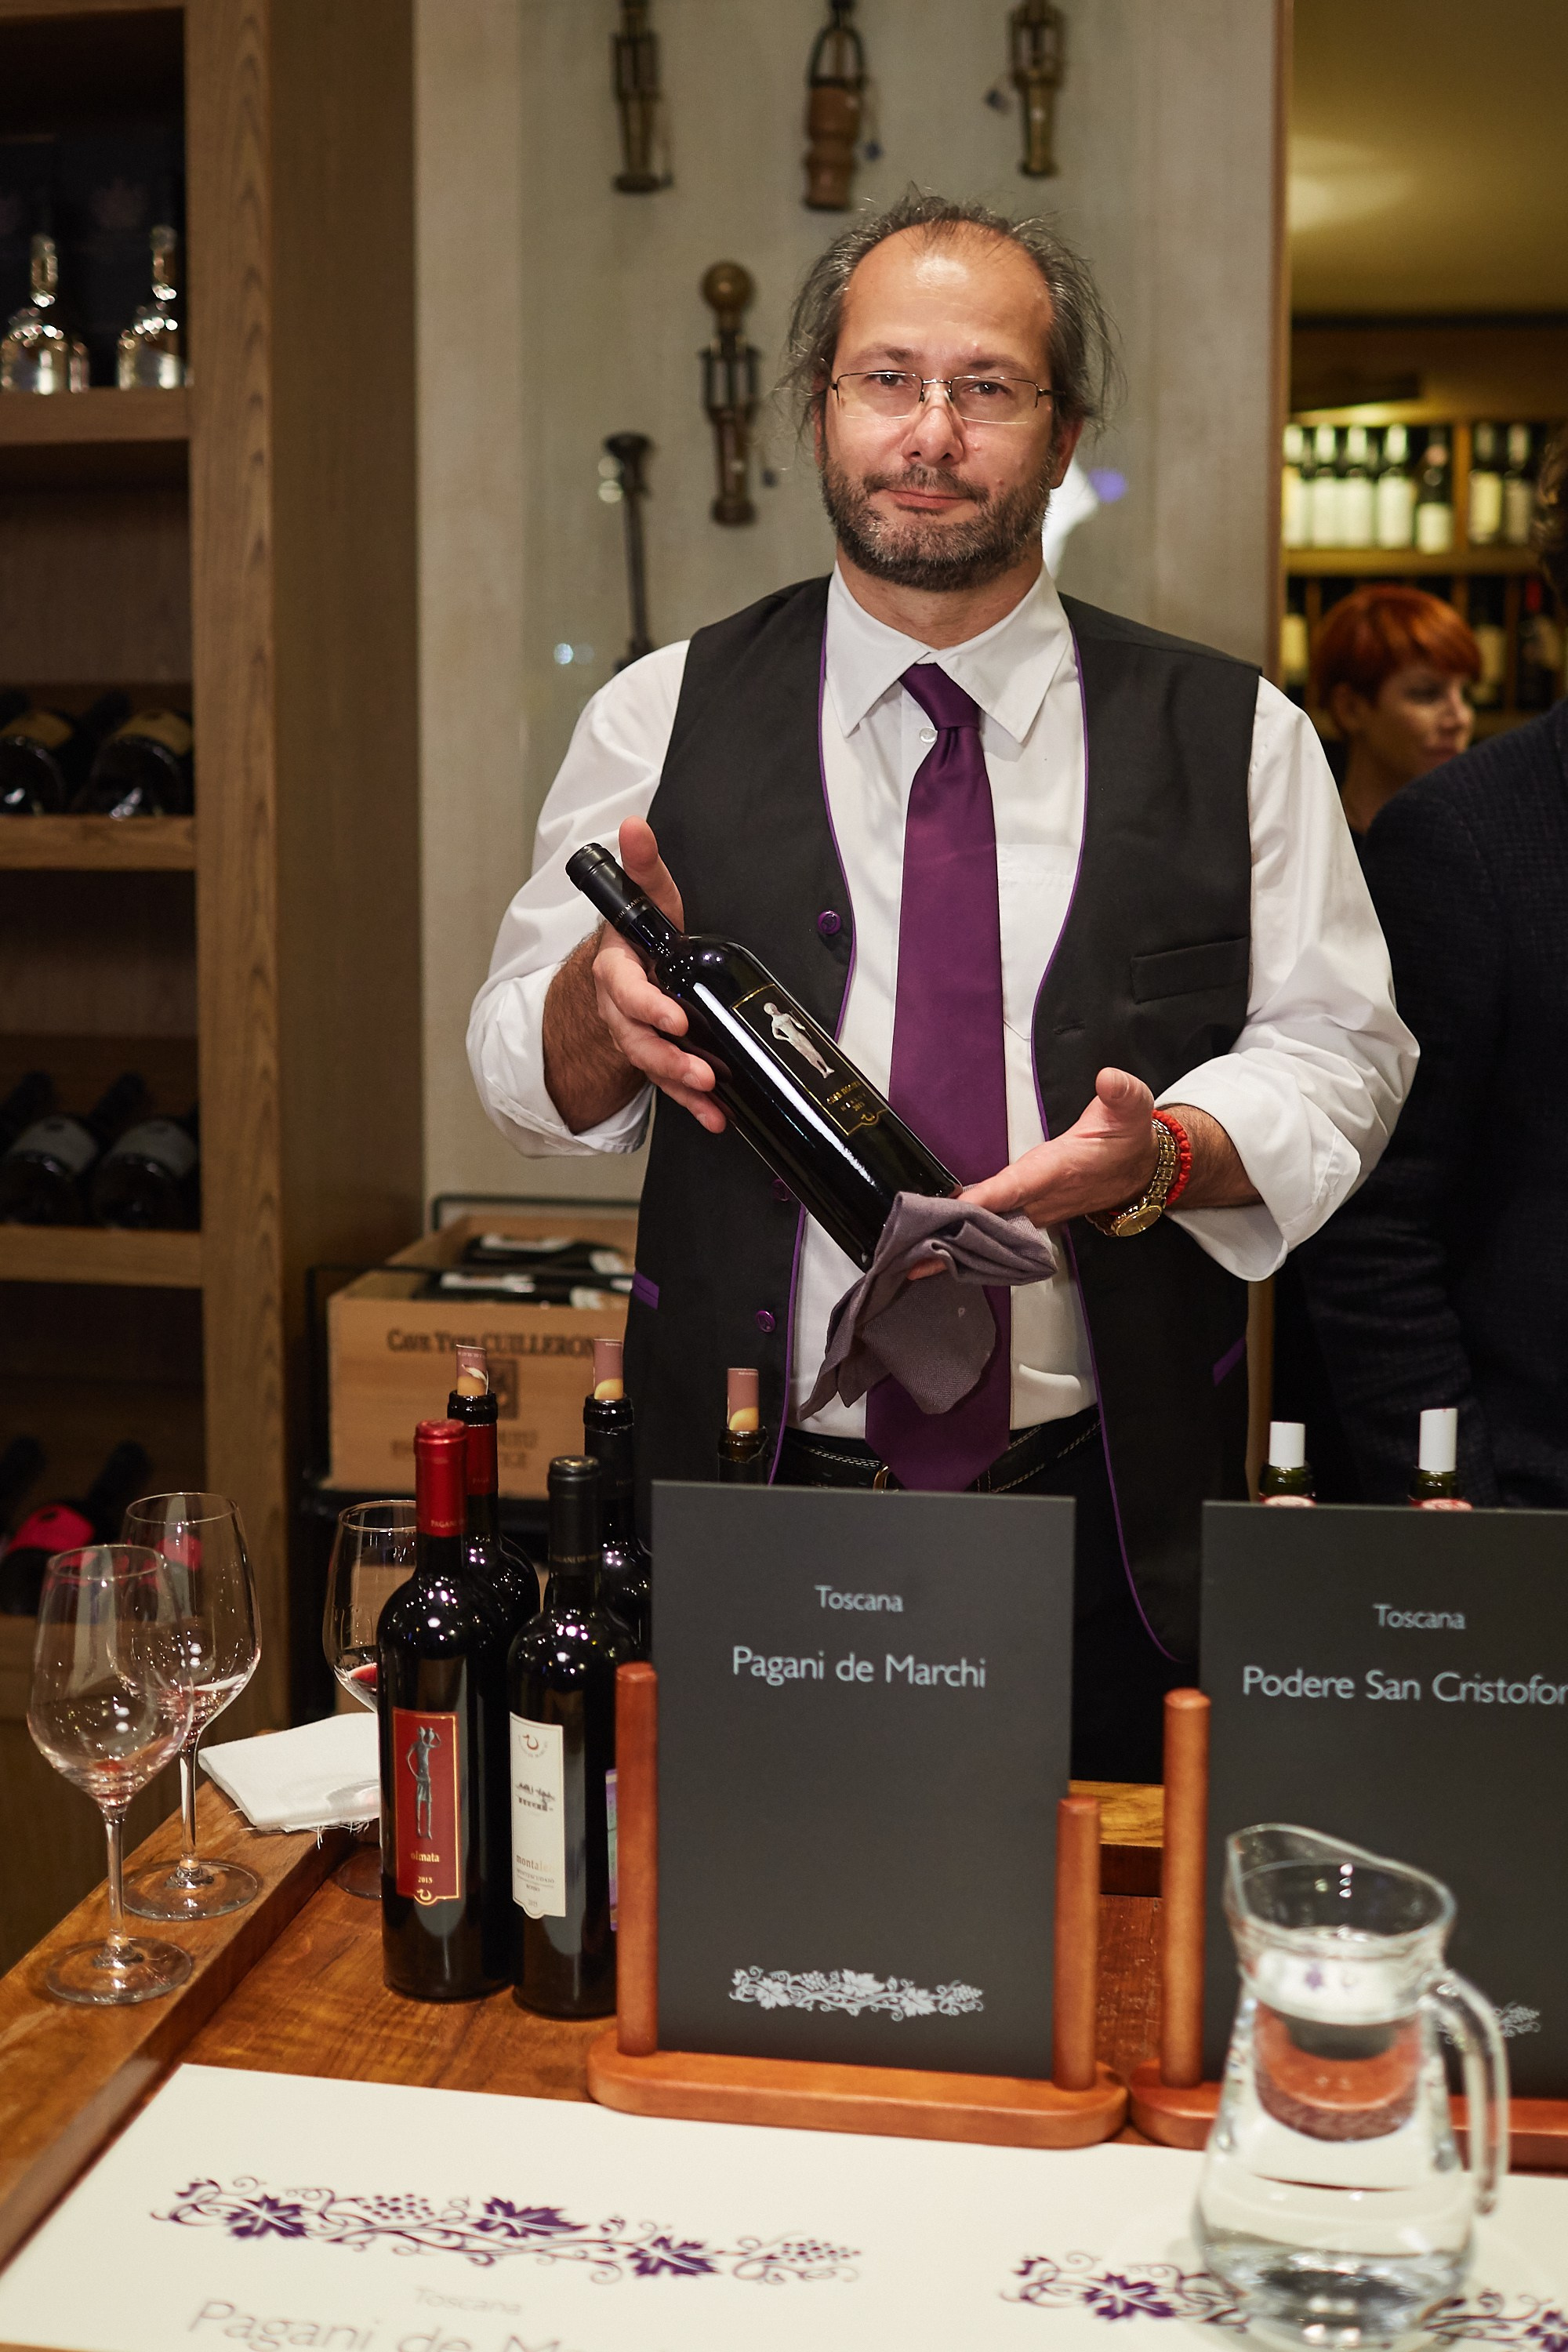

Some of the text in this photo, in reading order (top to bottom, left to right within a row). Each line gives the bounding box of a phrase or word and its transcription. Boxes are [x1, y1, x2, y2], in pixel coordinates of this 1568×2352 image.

[814, 1584, 904, 1613] Toscana
[1372, 1602, 1466, 1630] Toscana
[732, 1646, 987, 1688] Pagani de Marchi
[1243, 1665, 1568, 1705] Podere San Cristofor
[413, 2285, 523, 2316] Toscana
[187, 2299, 383, 2352] Pagani
